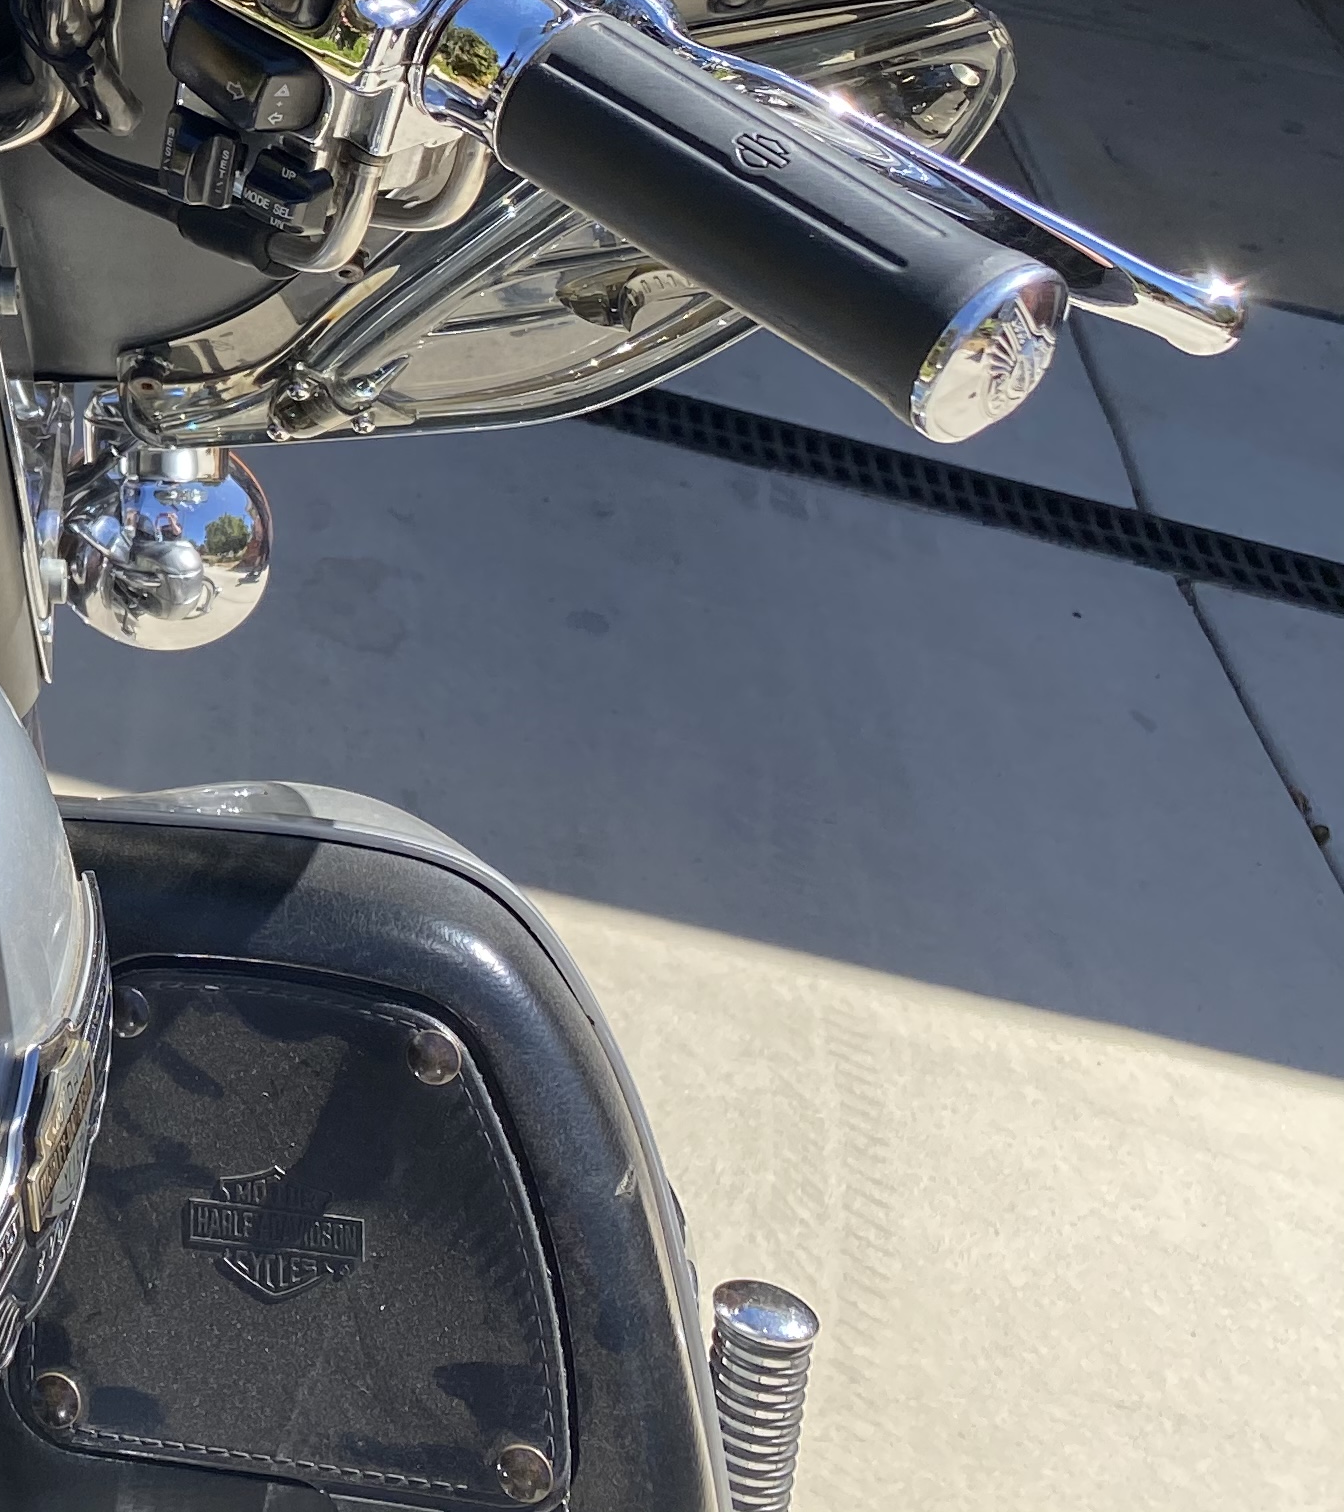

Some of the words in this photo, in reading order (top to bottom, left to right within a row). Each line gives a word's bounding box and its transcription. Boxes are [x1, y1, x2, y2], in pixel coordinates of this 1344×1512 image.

[281, 167, 297, 180] UP
[242, 187, 271, 209] MODE
[197, 1206, 357, 1252] HARLEDAVIDSON
[235, 1249, 317, 1290] CYCLES
